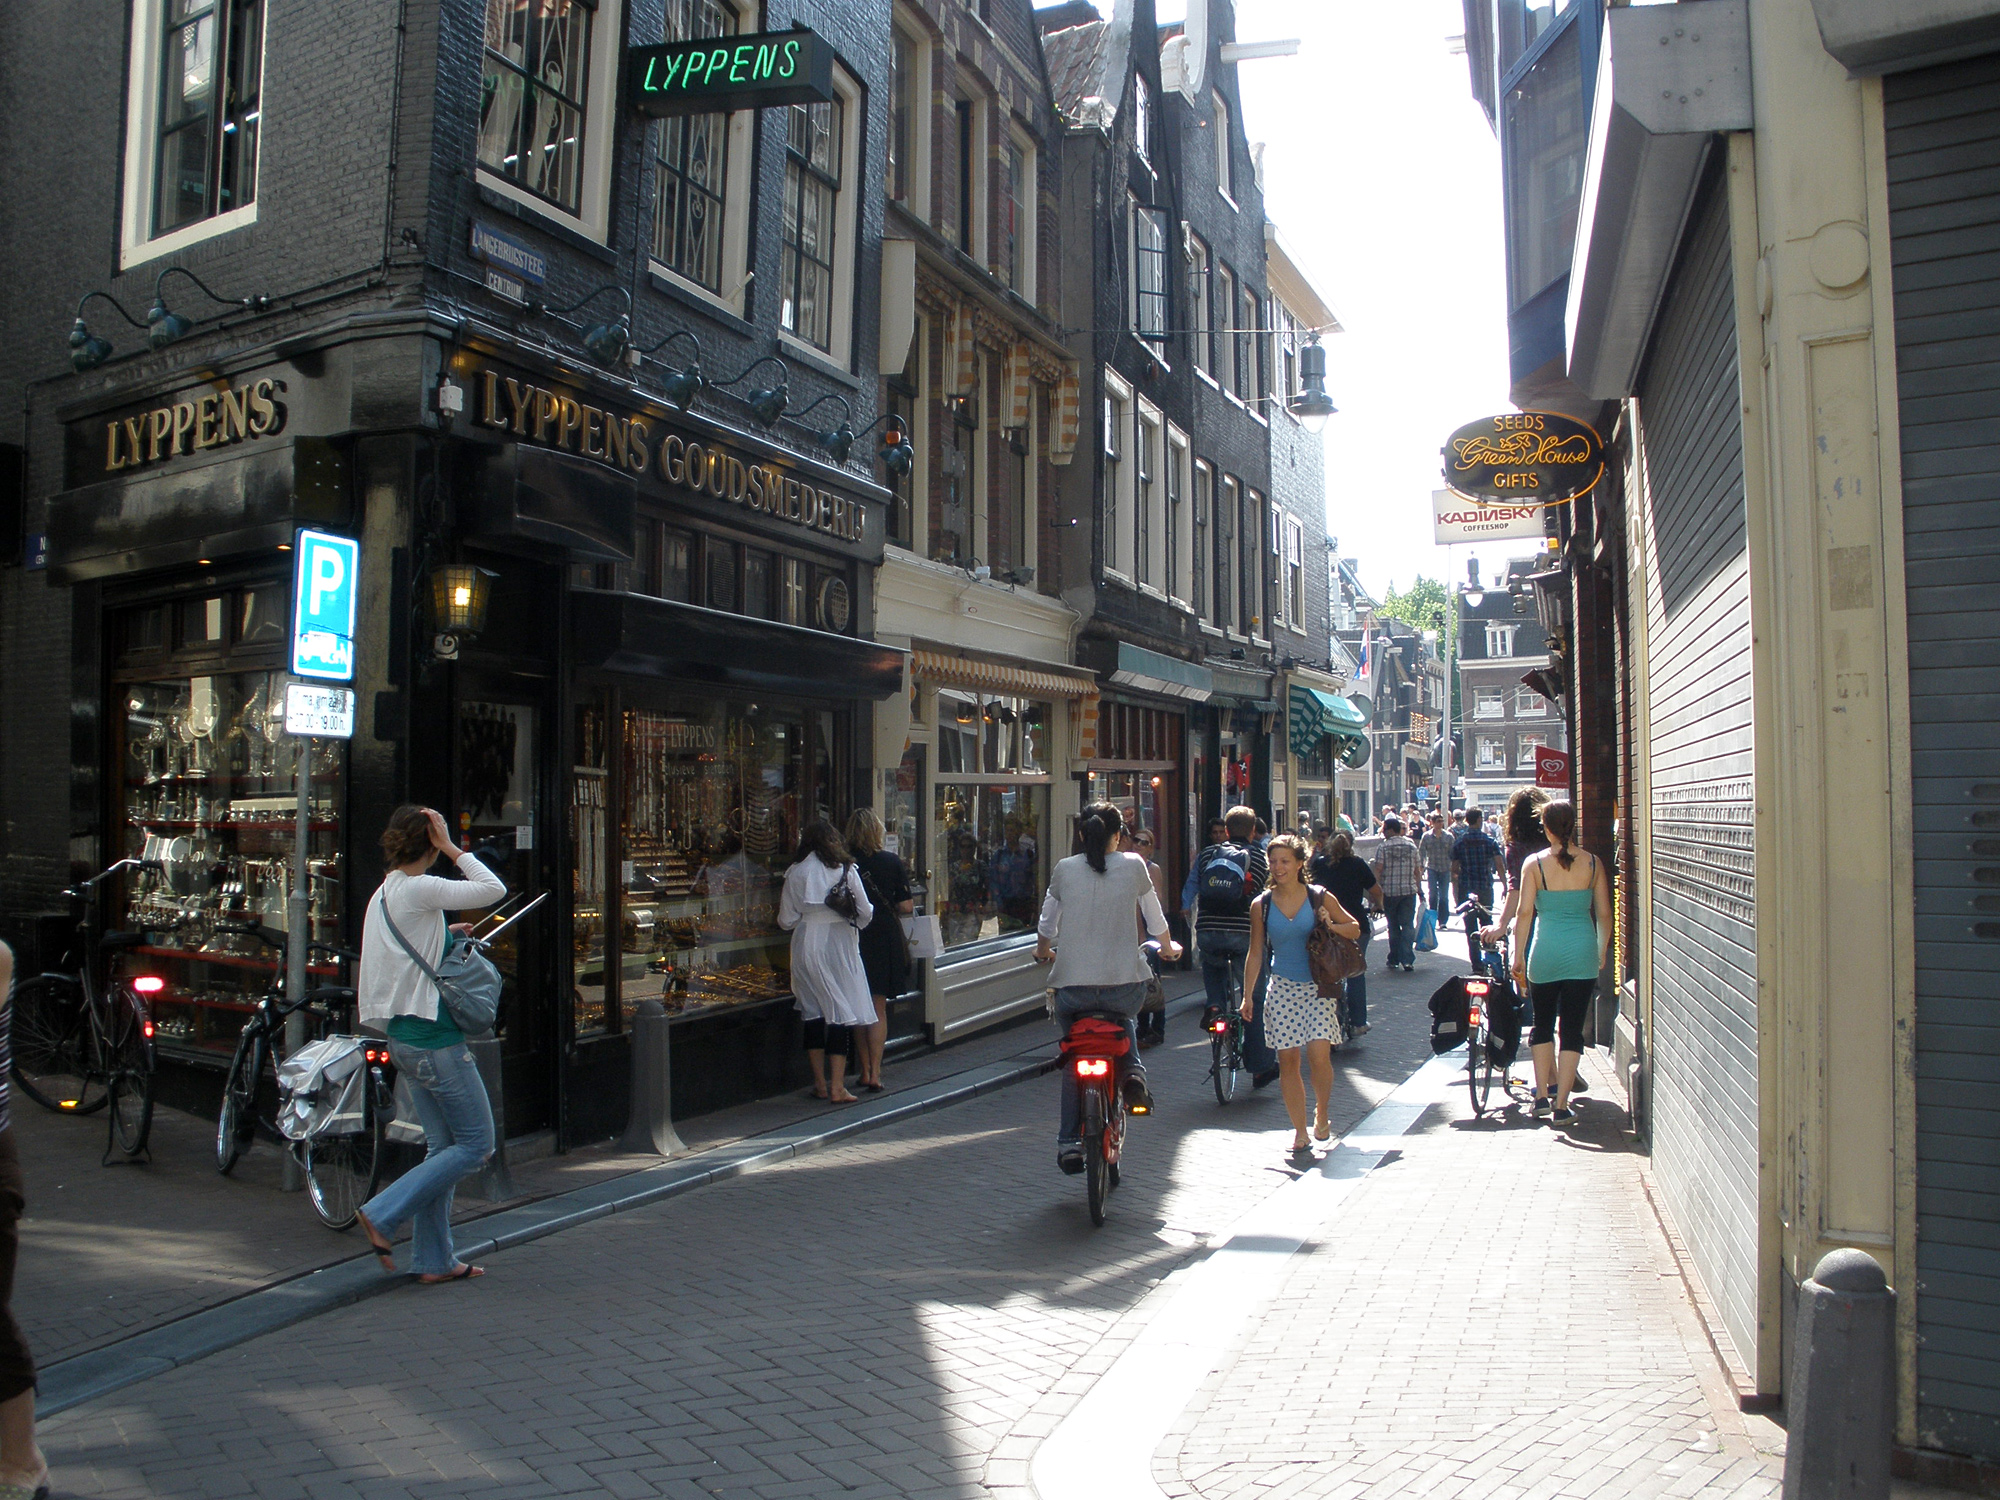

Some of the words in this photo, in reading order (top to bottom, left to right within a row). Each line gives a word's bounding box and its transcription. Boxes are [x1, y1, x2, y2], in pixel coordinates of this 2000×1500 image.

[643, 40, 800, 92] LYPPENS
[488, 272, 522, 301] CENTRUM
[105, 377, 275, 471] LYPPENS
[1493, 415, 1545, 432] SEEDS
[483, 369, 650, 474] LYPPENS
[661, 434, 867, 543] GOUDSMEDERIJ
[1453, 434, 1526, 471] Green
[1520, 431, 1591, 465] House
[1494, 472, 1539, 488] GIFTS
[1437, 507, 1538, 525] KADINSKY
[1463, 523, 1509, 532] COFFEESHOP
[309, 544, 345, 616] P
[671, 725, 715, 748] LYPPENS
